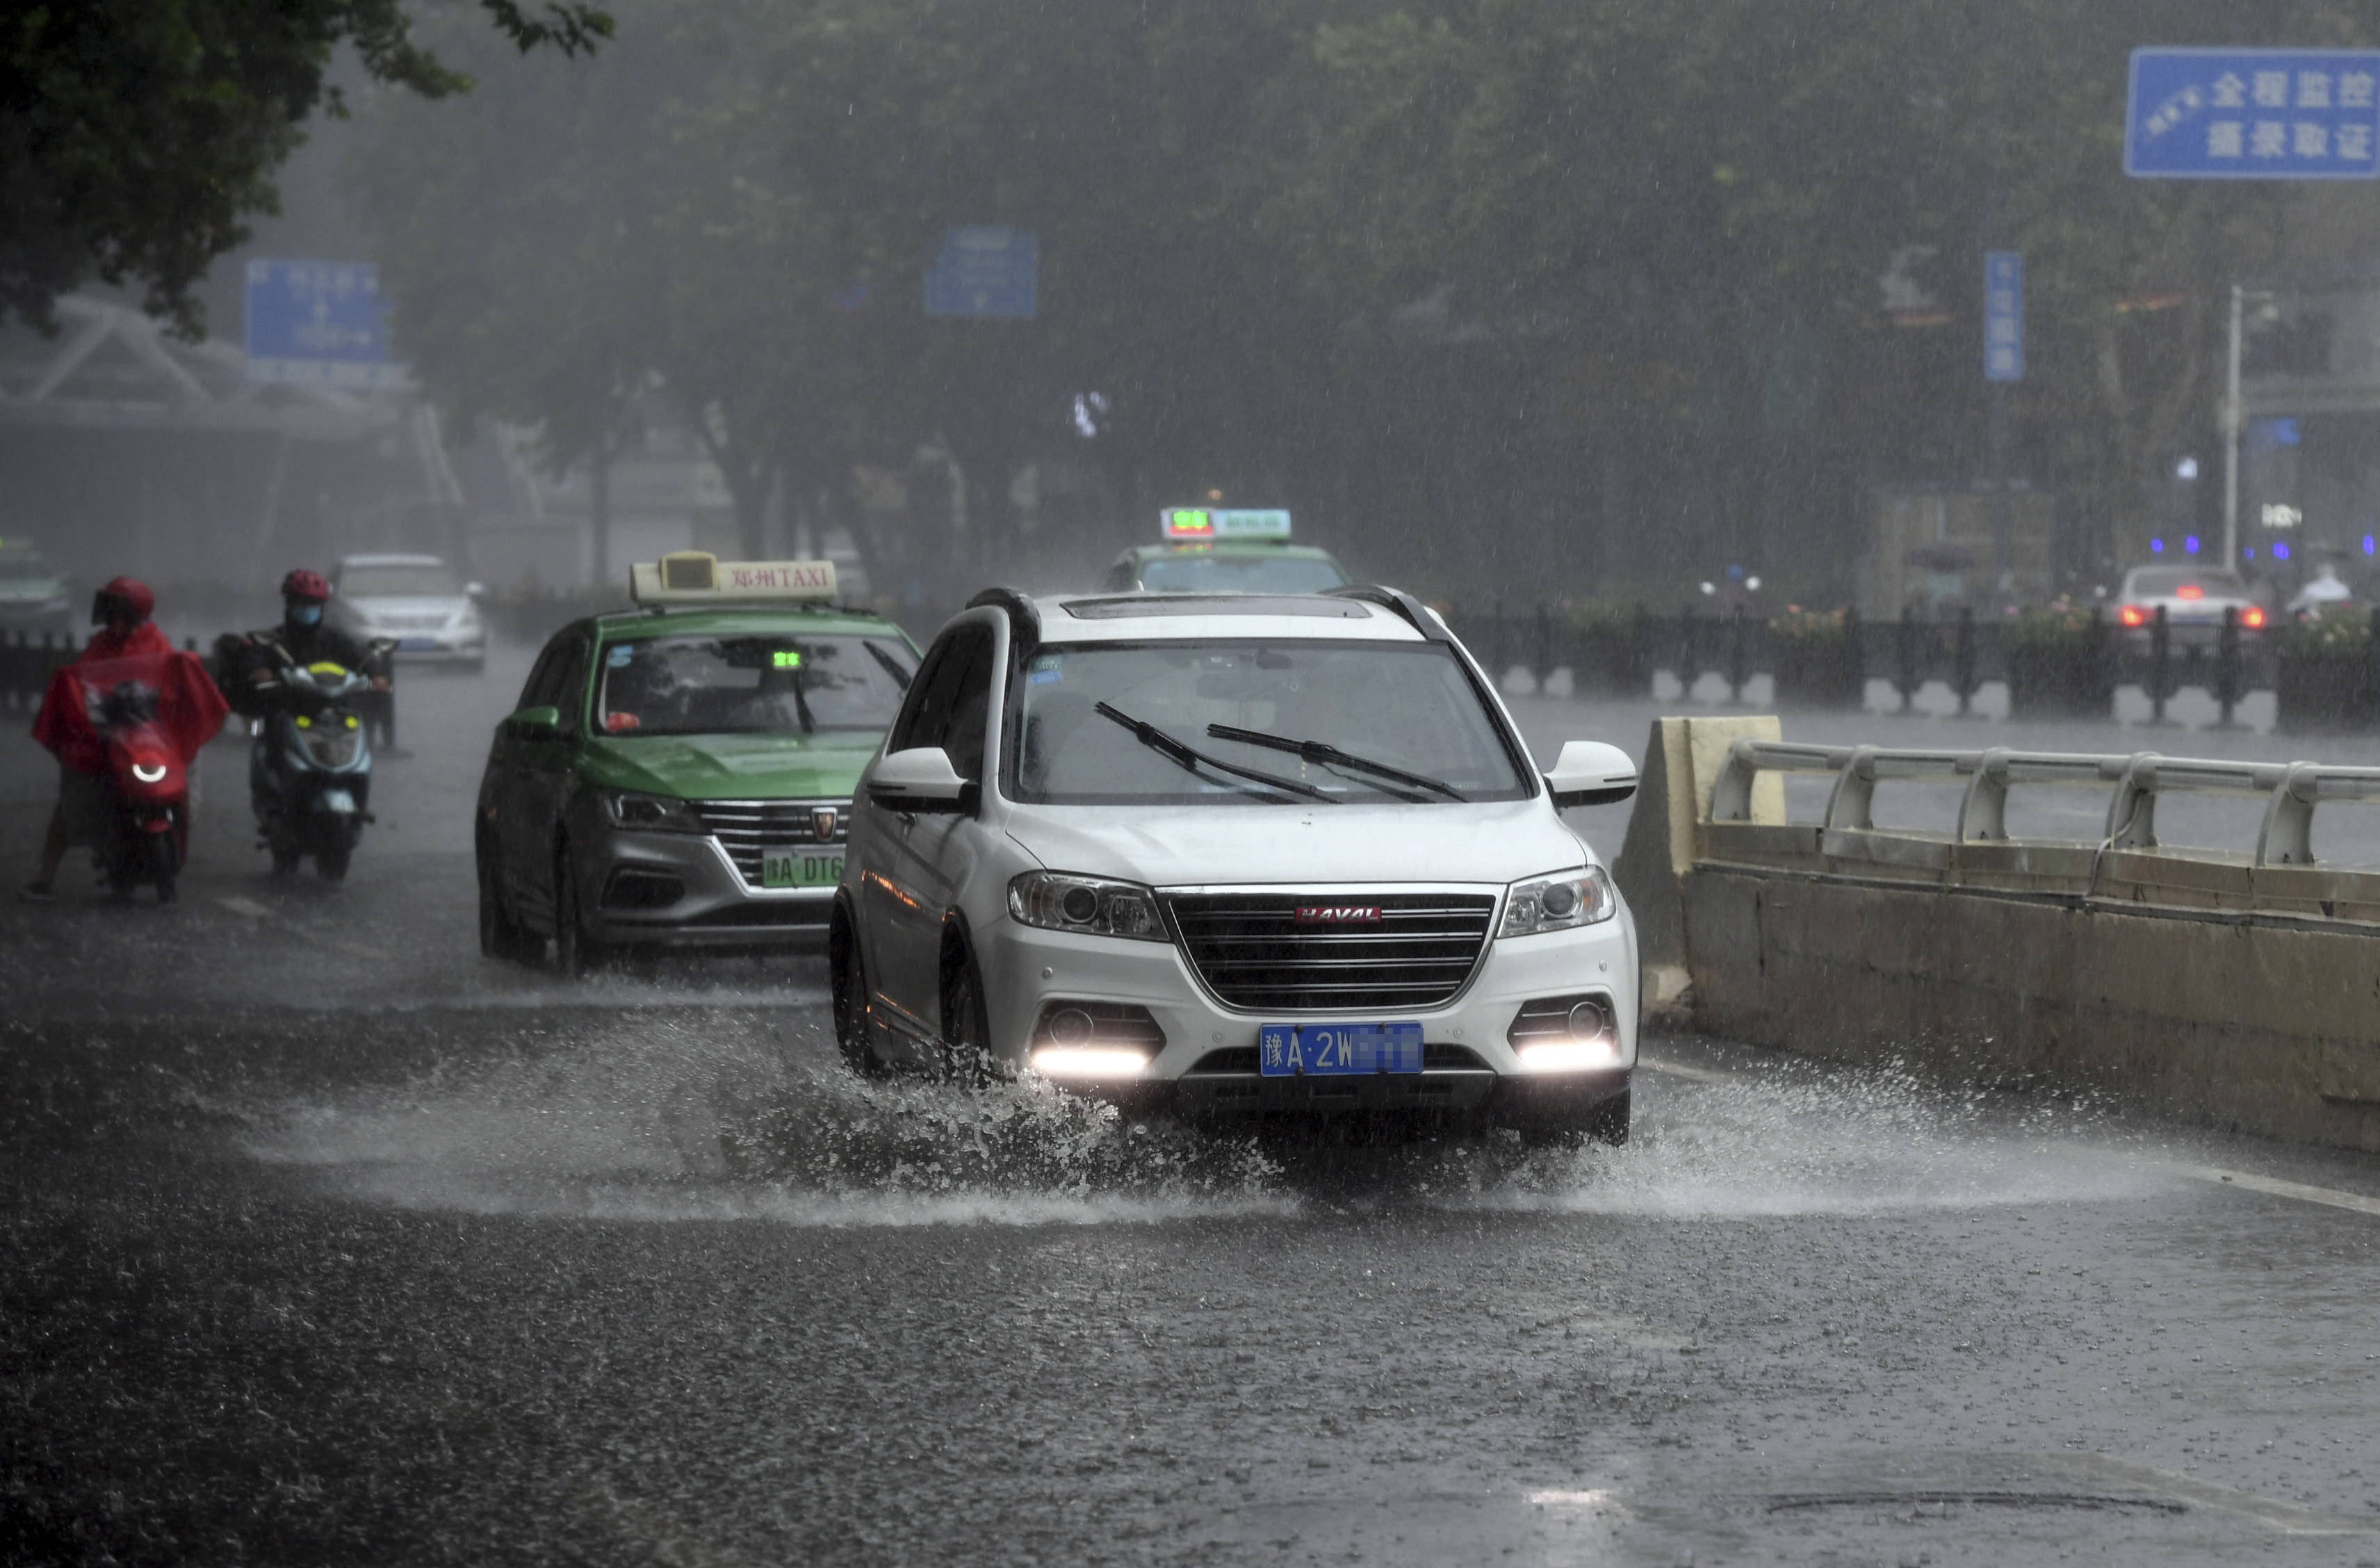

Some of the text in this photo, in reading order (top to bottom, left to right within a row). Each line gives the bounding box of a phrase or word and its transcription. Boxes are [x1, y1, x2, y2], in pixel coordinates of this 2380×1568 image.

[731, 568, 829, 587] 郑州 TAXI
[1301, 908, 1379, 922] HAVAL
[1265, 1031, 1419, 1068] 豫A·2W
